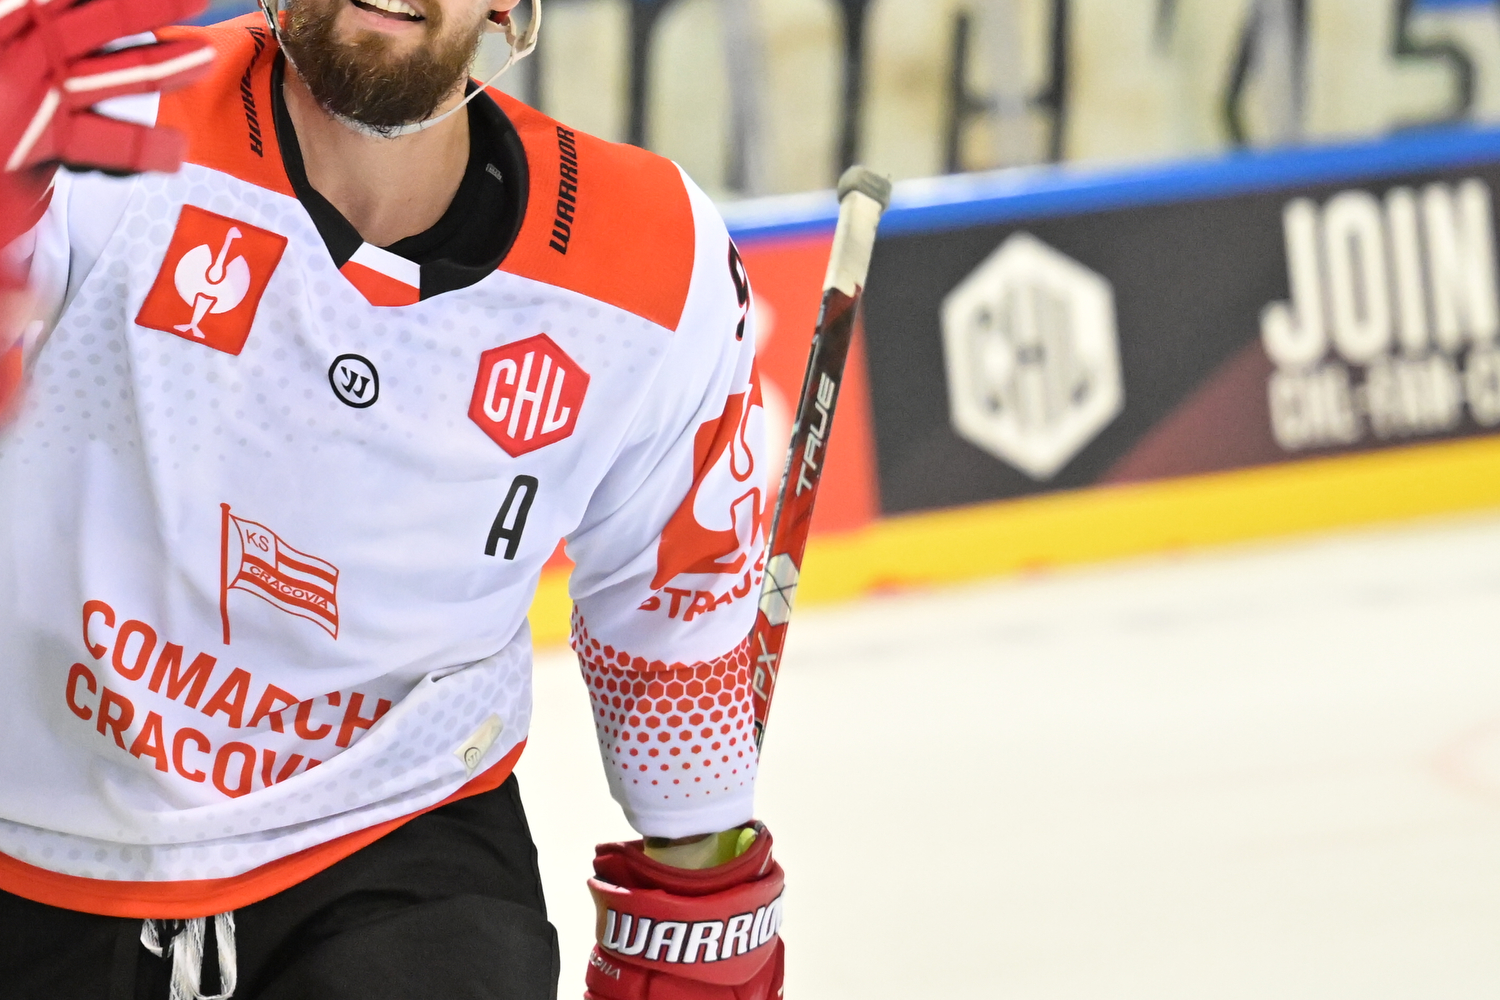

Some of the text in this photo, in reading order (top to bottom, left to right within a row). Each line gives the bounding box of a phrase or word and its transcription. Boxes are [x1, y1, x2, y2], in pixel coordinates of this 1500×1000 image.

[548, 125, 578, 256] WARRIOR
[1260, 178, 1498, 370] JOIN
[482, 350, 571, 442] CHL
[795, 371, 837, 498] TRUE
[245, 528, 270, 553] KS
[483, 473, 539, 561] A
[249, 565, 330, 610] CRACOVIA
[82, 599, 392, 749] COMARCH
[65, 662, 323, 799] CRACOV
[601, 884, 786, 965] WARRIO
